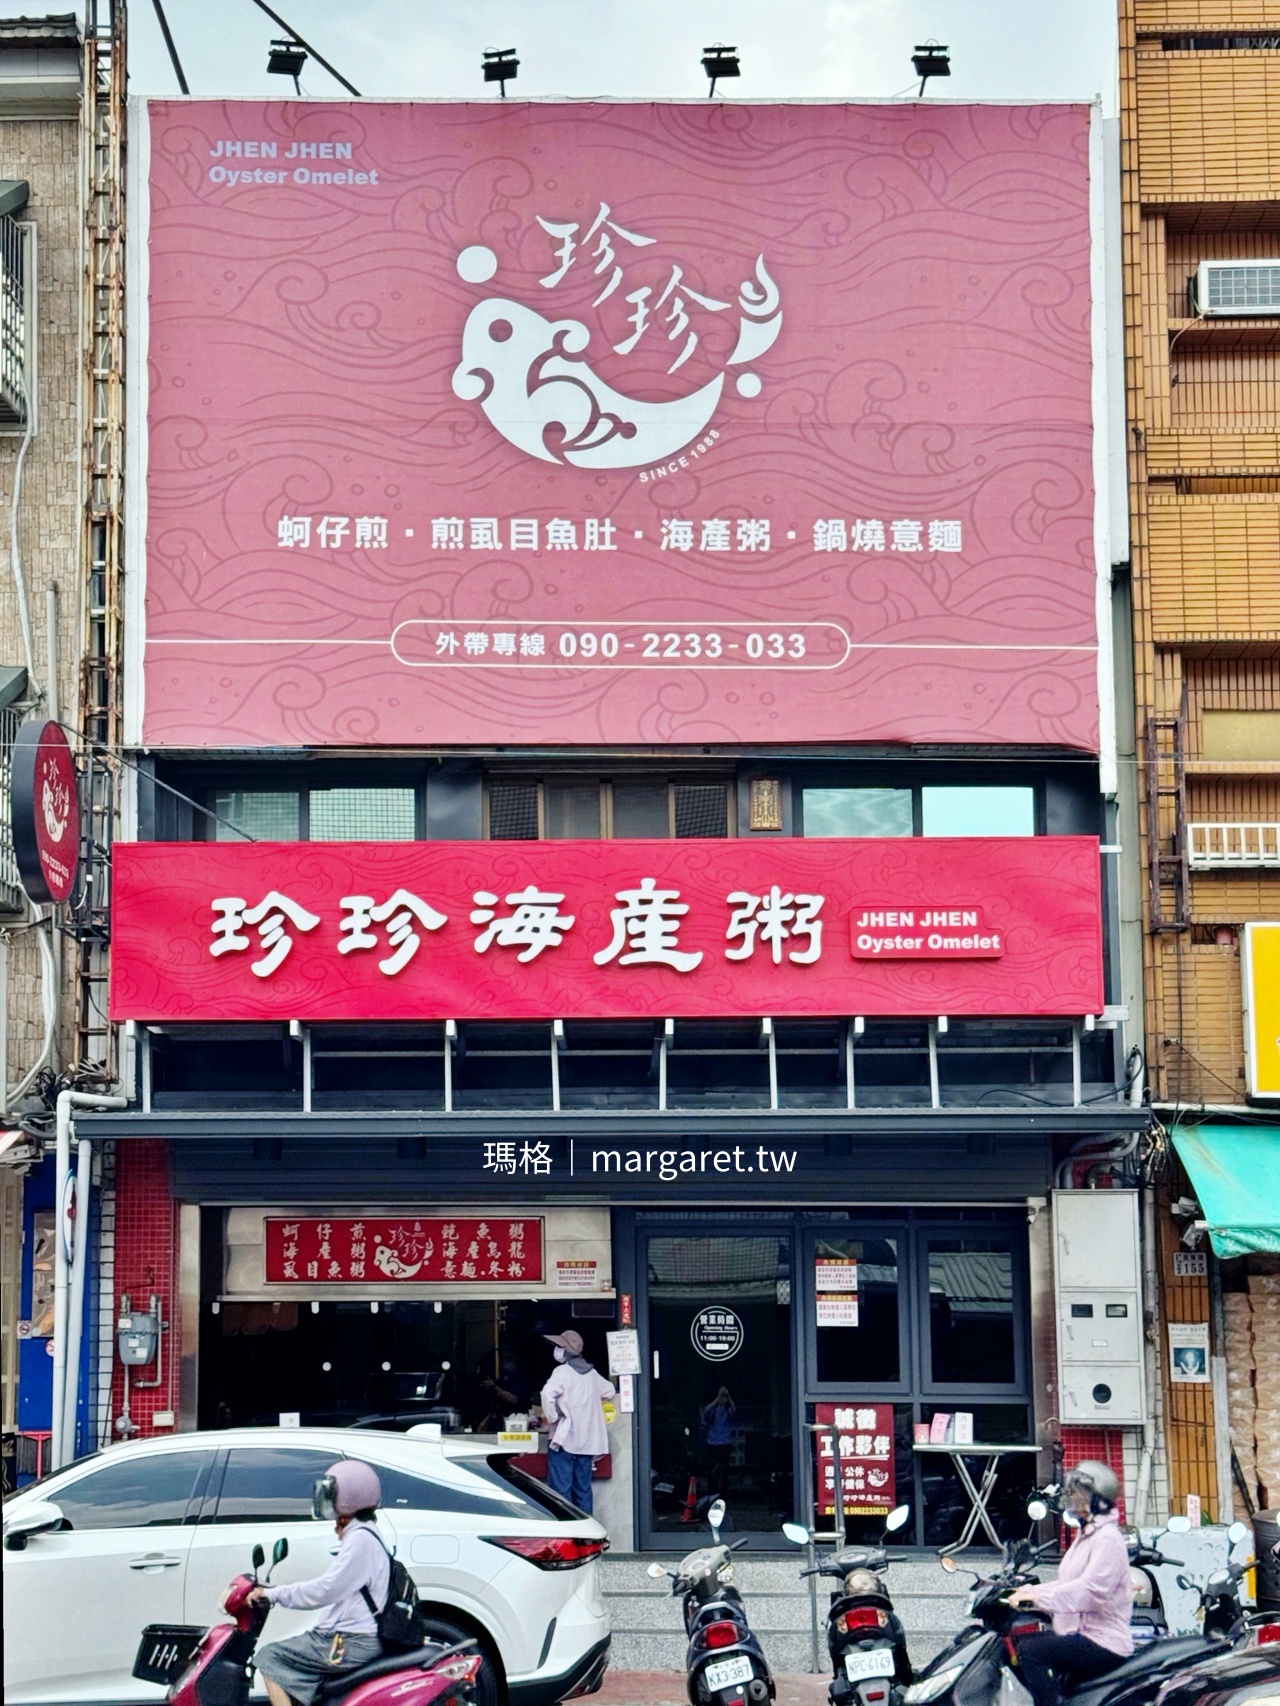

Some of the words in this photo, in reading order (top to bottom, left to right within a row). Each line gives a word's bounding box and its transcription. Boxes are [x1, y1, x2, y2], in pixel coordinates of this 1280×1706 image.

[209, 140, 277, 158] JHEN
[284, 142, 352, 159] JHEN
[208, 166, 288, 187] Oyster
[293, 167, 379, 185] Omelet
[535, 201, 733, 375] 珍珍
[639, 455, 690, 483] SINCE
[690, 429, 720, 459] 1988
[435, 631, 546, 657] 外帶專線
[558, 632, 807, 659] 090-2233-033
[856, 911, 915, 928] JHEN
[919, 911, 978, 927] JHEN
[856, 934, 924, 954] Oyster
[927, 933, 1001, 950] Omelet
[441, 1222, 525, 1241] 鮑魚粥
[1184, 1263, 1205, 1274] 155
[708, 1663, 751, 1687] KX3-387
